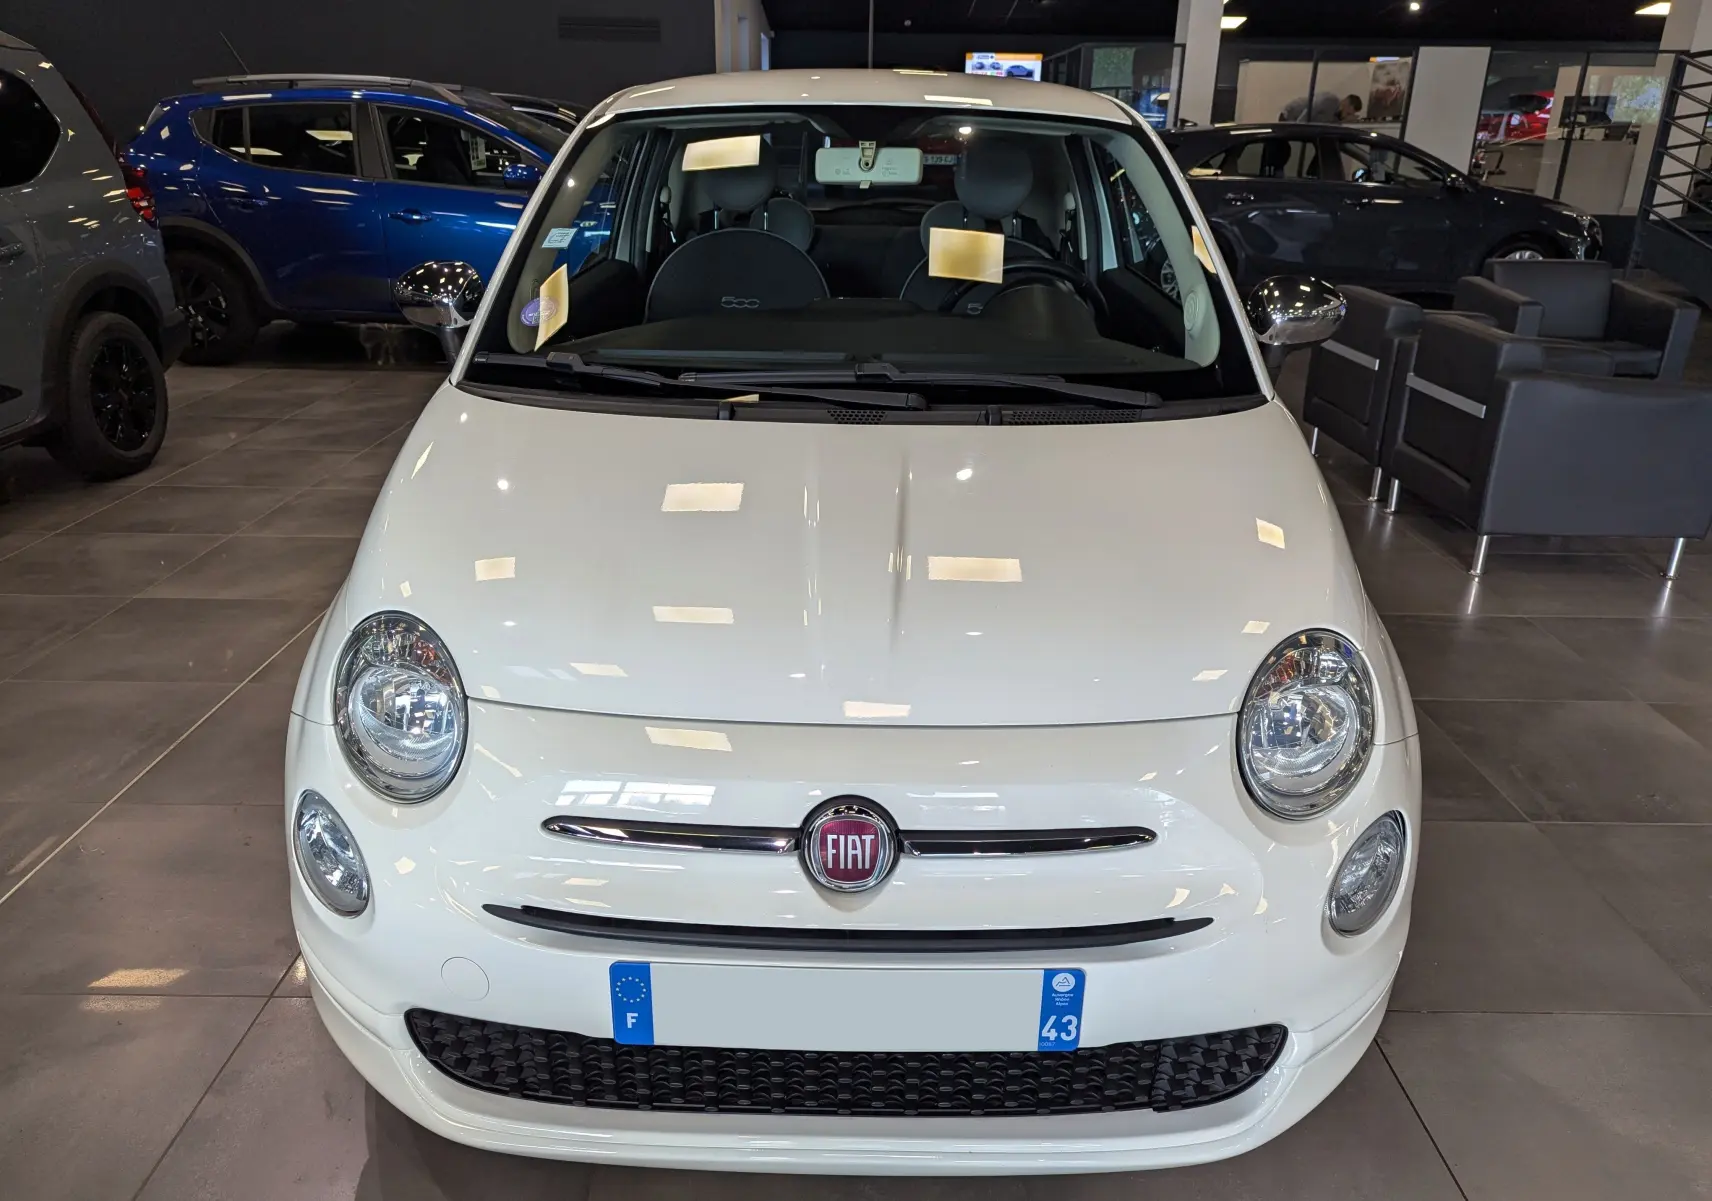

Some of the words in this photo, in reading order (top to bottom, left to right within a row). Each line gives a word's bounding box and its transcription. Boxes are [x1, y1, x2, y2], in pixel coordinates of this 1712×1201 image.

[721, 296, 760, 308] 500
[827, 834, 875, 869] FIAT
[626, 1012, 639, 1029] F
[1041, 1015, 1077, 1041] 43
